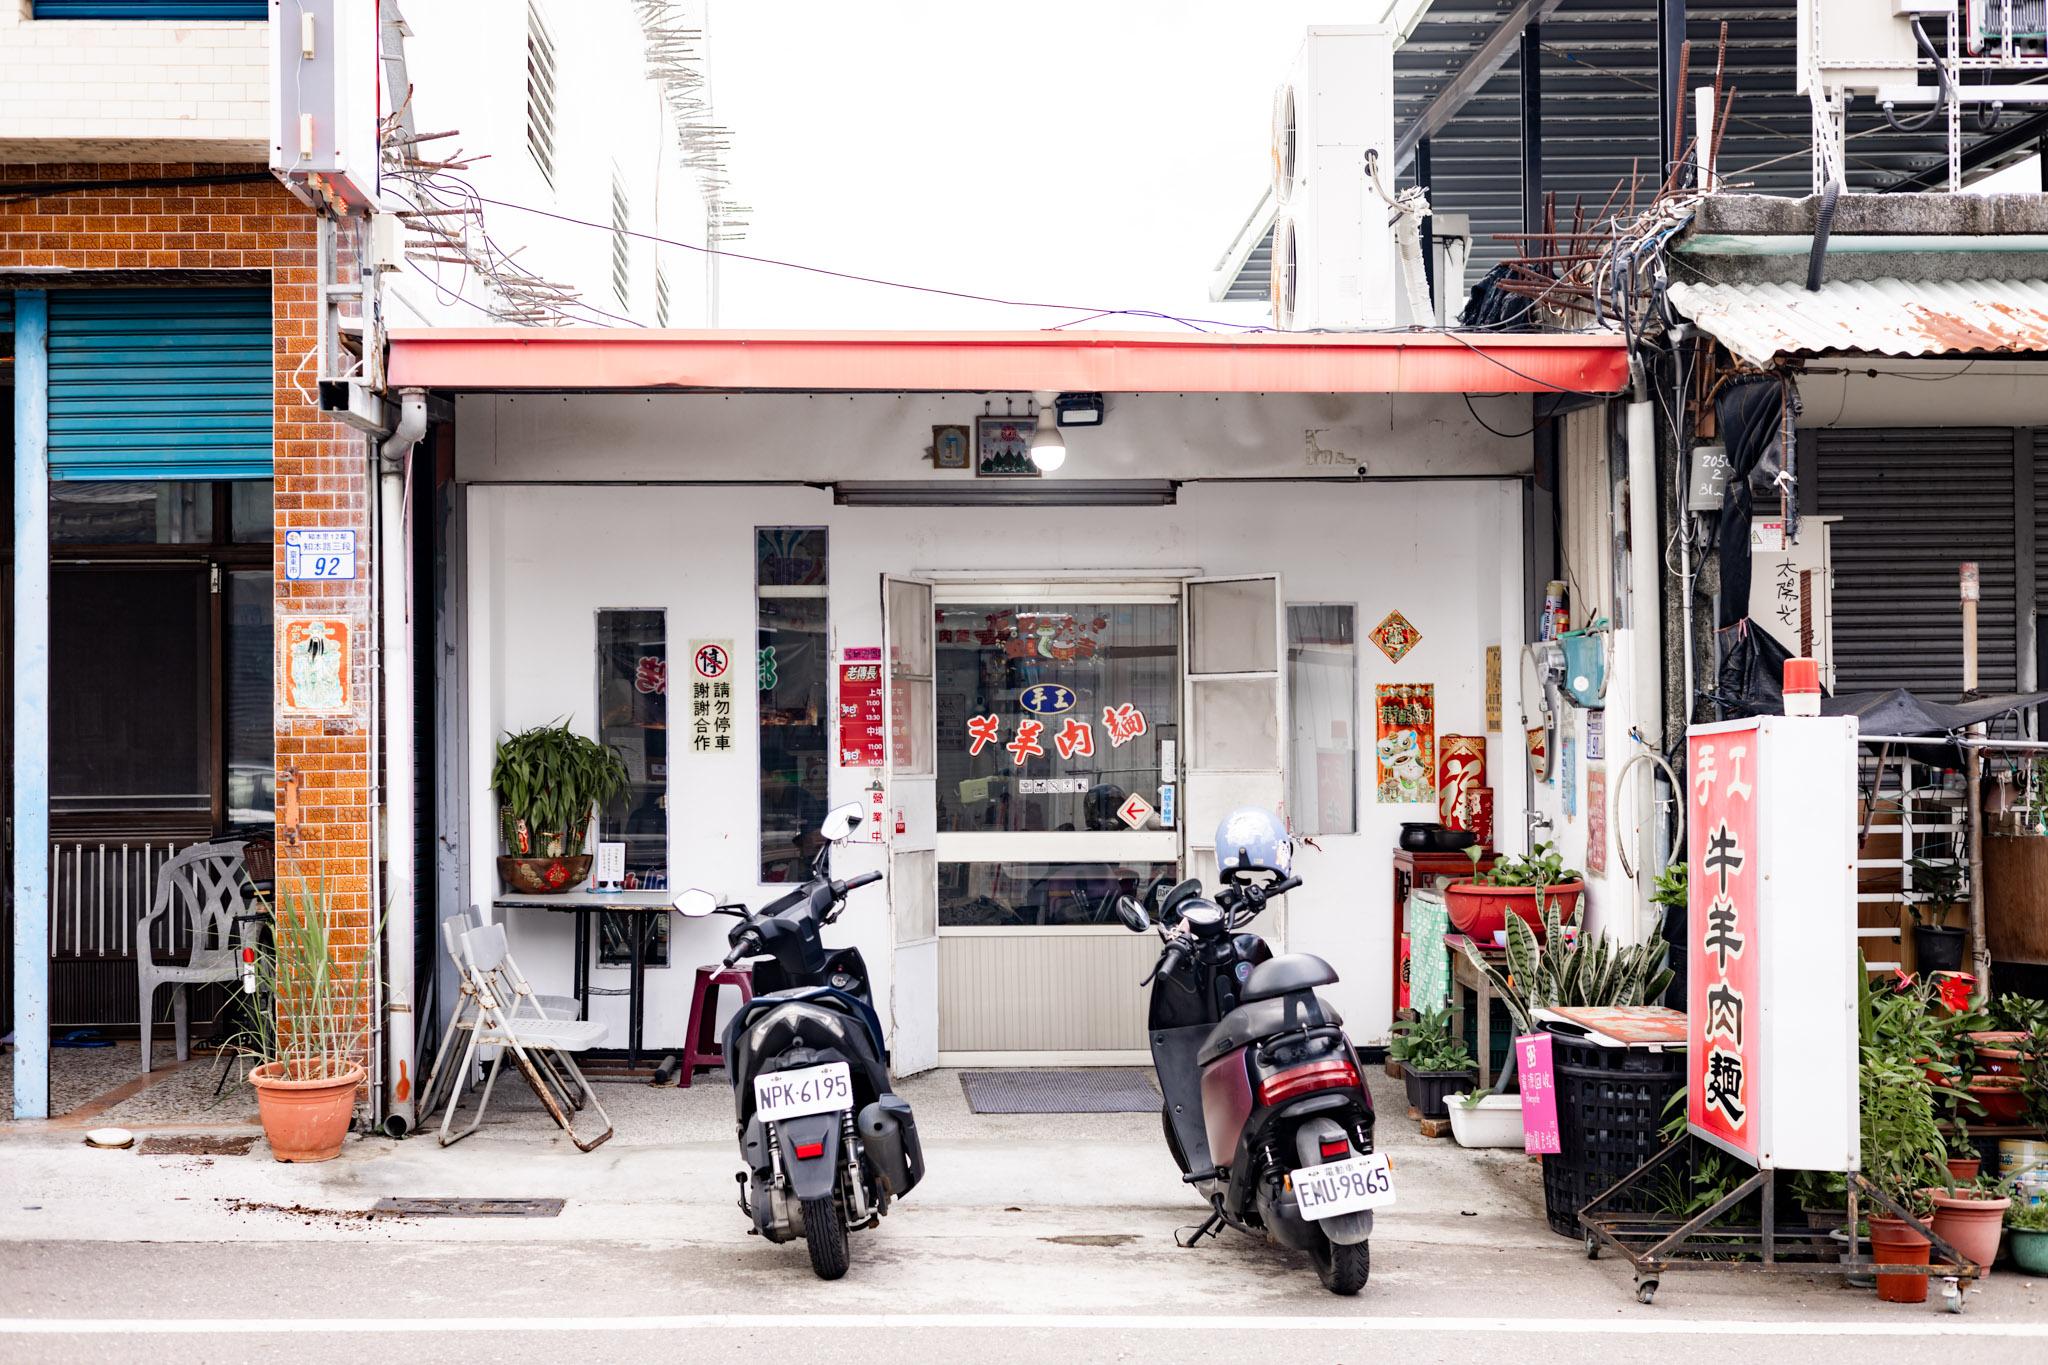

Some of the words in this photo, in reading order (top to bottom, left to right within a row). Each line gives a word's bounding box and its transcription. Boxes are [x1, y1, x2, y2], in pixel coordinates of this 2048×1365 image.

[1712, 469, 1723, 480] 2
[304, 542, 351, 551] 知本路三段
[314, 557, 340, 576] 92
[693, 682, 710, 751] 謝謝合作
[714, 682, 731, 751] 請勿停車
[1032, 687, 1070, 711] 手工
[1695, 745, 1752, 806] 手工
[872, 792, 883, 841] 營業中
[1704, 820, 1746, 1126] 牛羊肉麵
